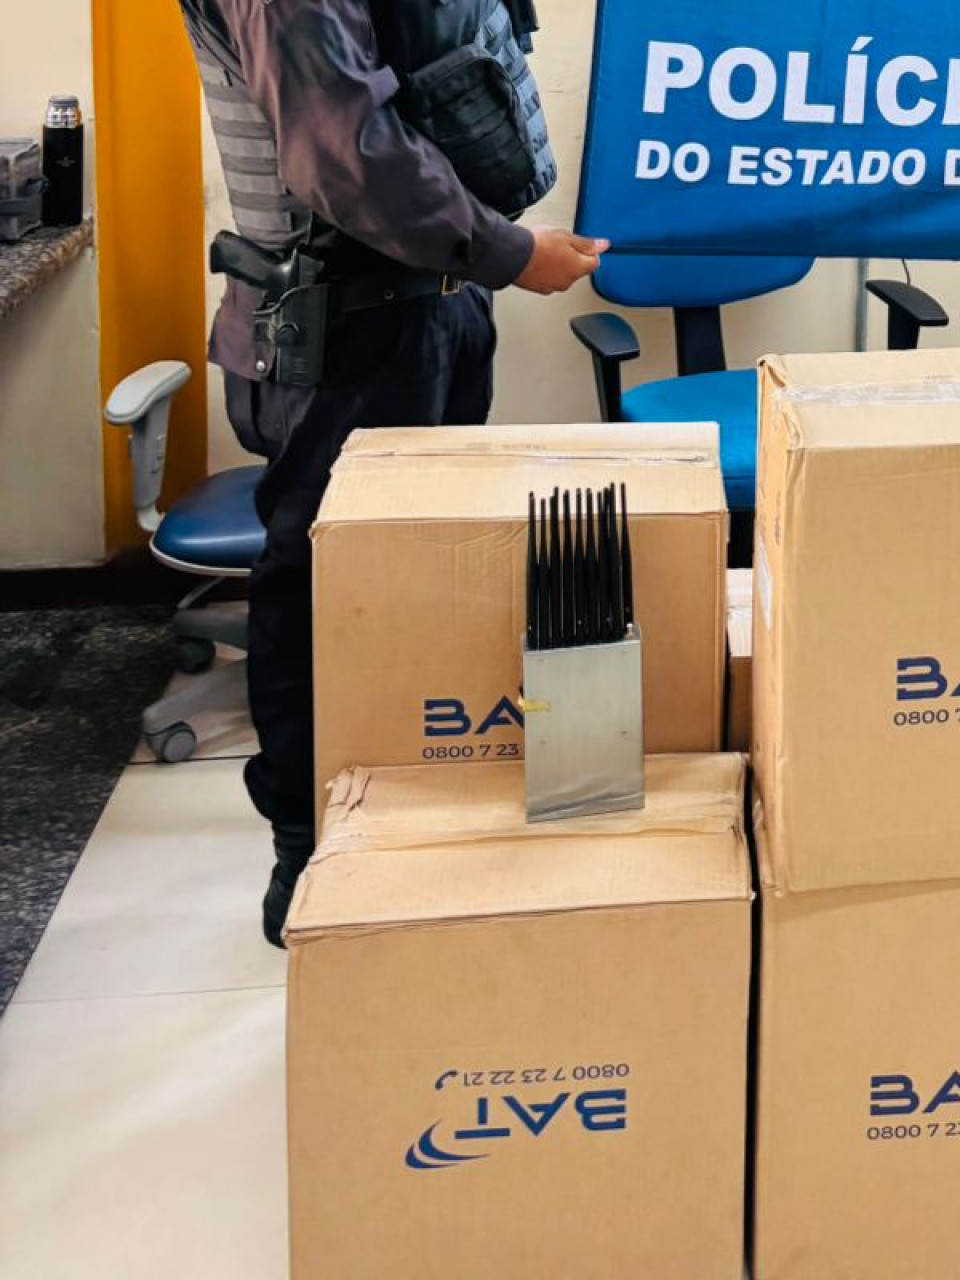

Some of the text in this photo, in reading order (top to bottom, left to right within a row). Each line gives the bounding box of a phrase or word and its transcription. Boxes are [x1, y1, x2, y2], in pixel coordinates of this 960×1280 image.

[635, 140, 710, 182] DO
[727, 146, 926, 186] ESTADO
[423, 695, 525, 736] BA
[893, 708, 950, 726] 0800
[422, 743, 519, 759] 0800 7 23
[463, 1071, 484, 1087] 21
[490, 1070, 516, 1085] 22
[521, 1068, 548, 1083] 23
[572, 1063, 630, 1081] 0800
[454, 1088, 627, 1140] BAT
[866, 1124, 921, 1140] 0800
[927, 1123, 939, 1137] 7
